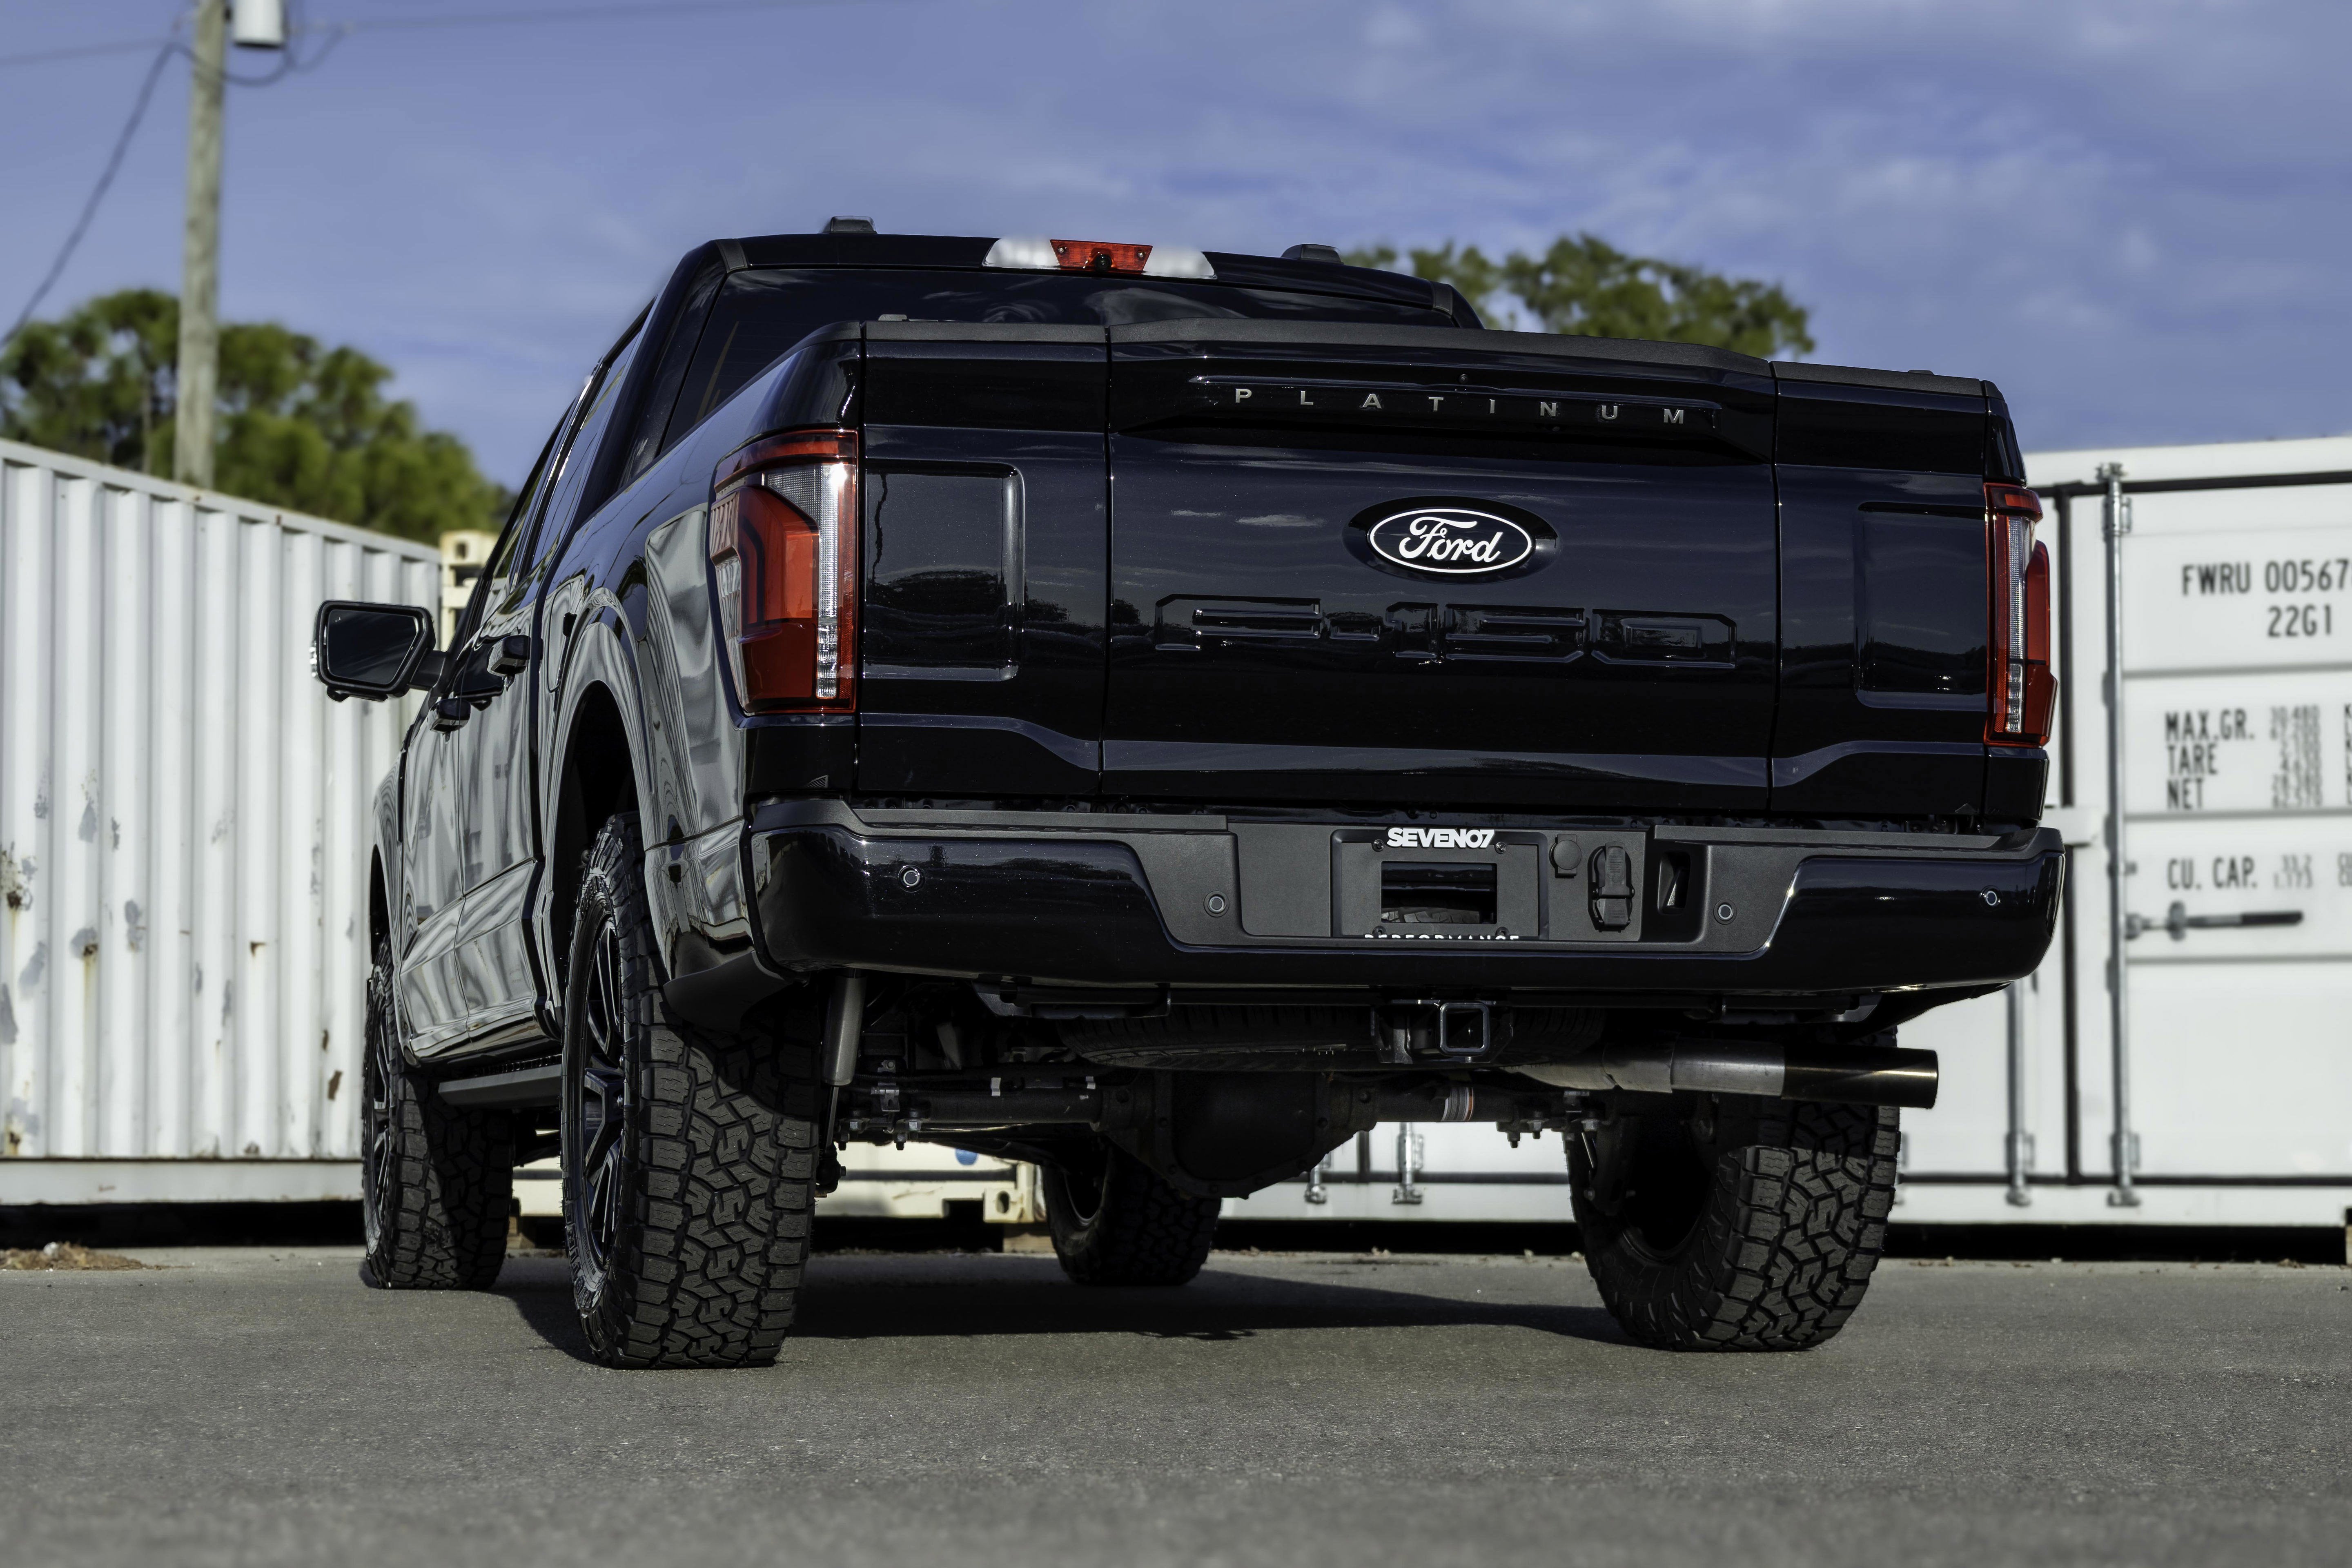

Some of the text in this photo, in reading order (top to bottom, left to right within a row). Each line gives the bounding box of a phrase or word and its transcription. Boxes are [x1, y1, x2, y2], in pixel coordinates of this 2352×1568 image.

[1235, 388, 1684, 425] PLATINUM
[1399, 517, 1503, 562] Ford
[2181, 558, 2352, 597] FWRU 00567
[2267, 603, 2332, 637] 22G1
[2167, 743, 2218, 776] TARE
[2167, 777, 2204, 810] NET
[2167, 858, 2202, 890] CU.
[2212, 856, 2257, 889] CAP.
